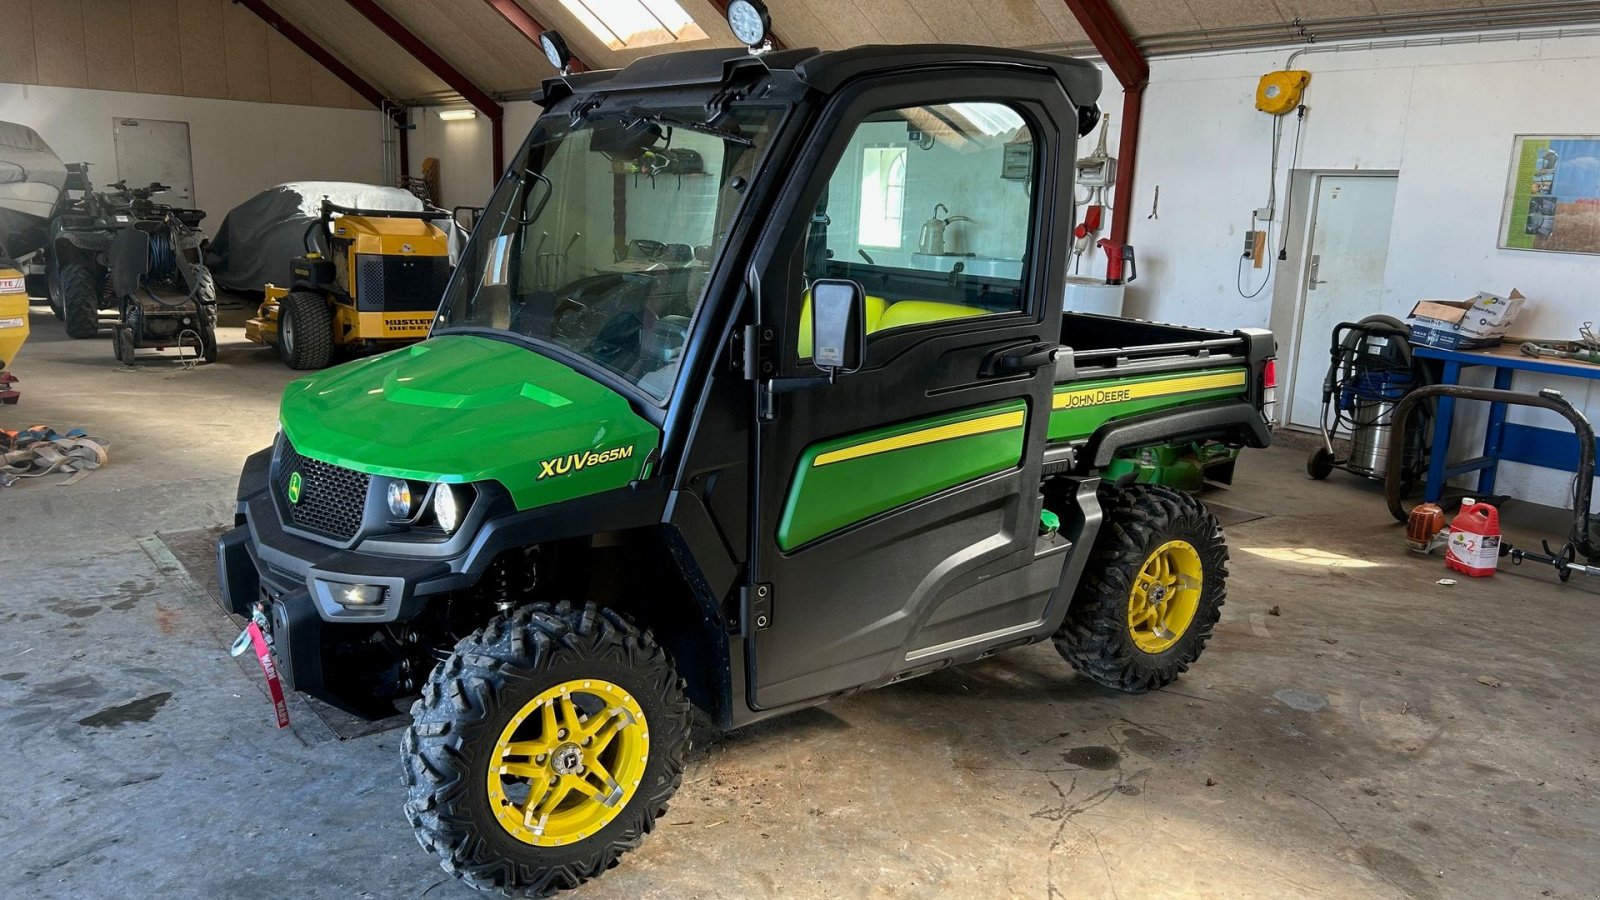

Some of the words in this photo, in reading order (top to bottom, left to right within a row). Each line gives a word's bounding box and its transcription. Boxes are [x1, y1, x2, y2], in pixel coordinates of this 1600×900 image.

[1065, 394, 1094, 407] JOHN
[1097, 389, 1130, 402] DEERE
[537, 444, 634, 479] XUV865M
[1467, 540, 1475, 552] 2
[260, 653, 276, 680] WARN
